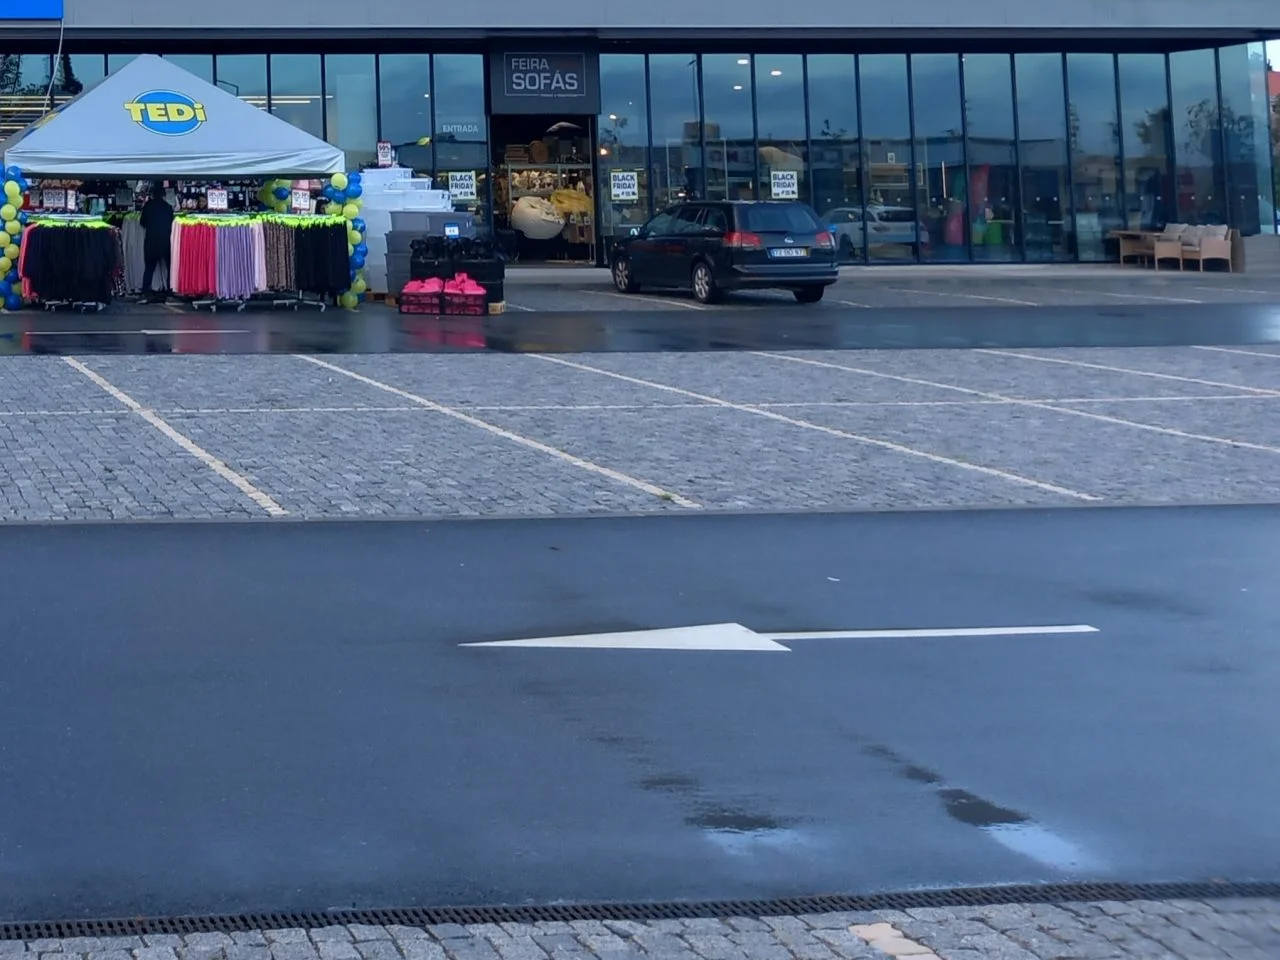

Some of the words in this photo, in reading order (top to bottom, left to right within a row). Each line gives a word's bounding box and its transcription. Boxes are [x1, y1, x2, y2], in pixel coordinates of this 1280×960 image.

[511, 58, 550, 70] FEIRA
[512, 70, 578, 90] SOFÁS
[123, 102, 207, 122] TEDi
[442, 124, 479, 134] ENTRADA
[612, 174, 636, 182] BLACK
[772, 173, 795, 181] BLACK
[450, 182, 474, 190] FRIDAY
[612, 182, 636, 190] FRIDAY
